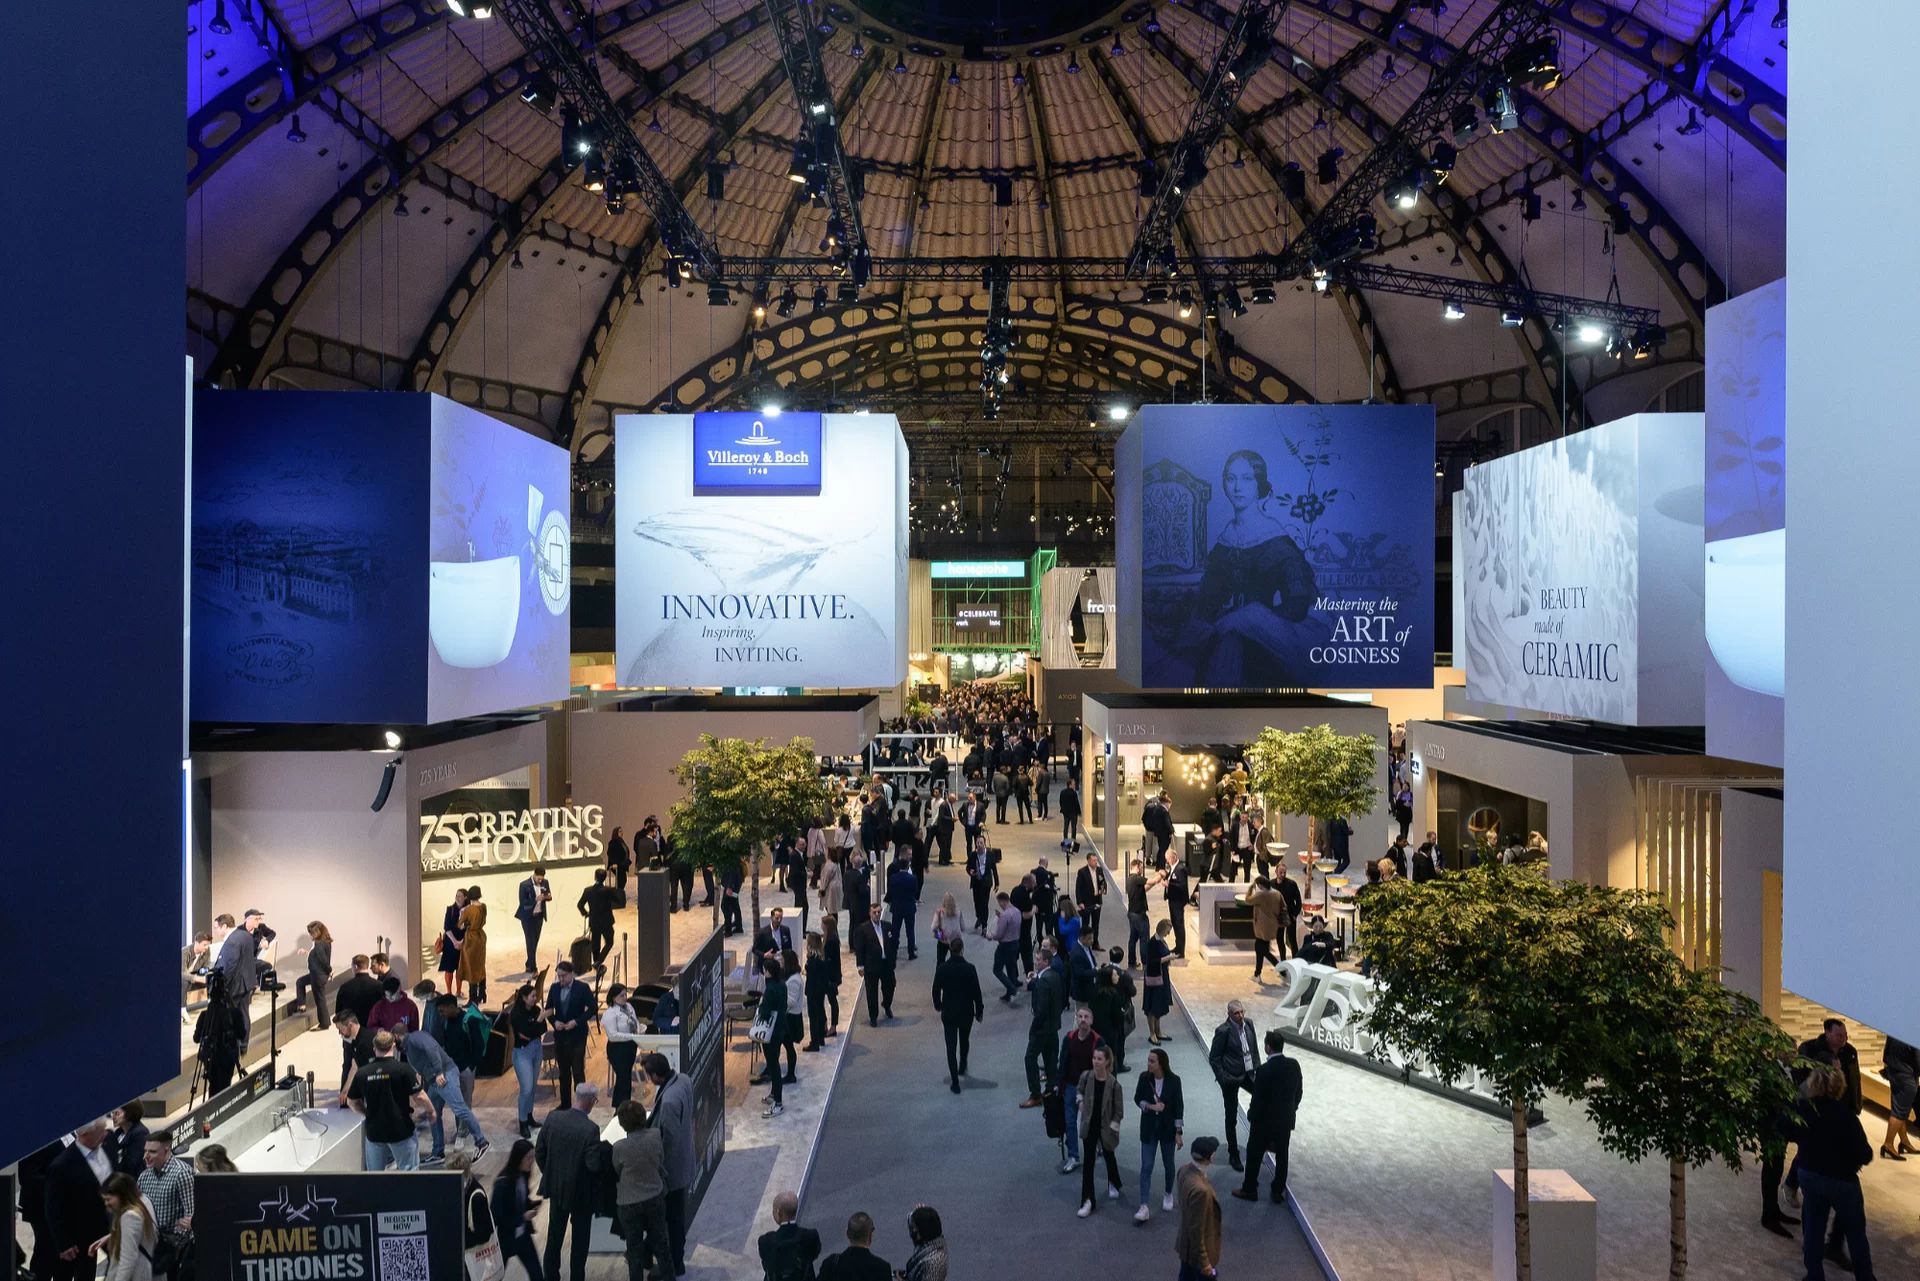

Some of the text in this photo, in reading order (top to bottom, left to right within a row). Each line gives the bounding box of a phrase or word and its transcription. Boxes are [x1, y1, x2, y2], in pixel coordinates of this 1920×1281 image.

[707, 450, 809, 465] Villeroy & Boch
[748, 467, 768, 475] 1748
[948, 561, 1009, 576] hansgrohe
[661, 594, 855, 620] INNOVATIVE.
[1314, 596, 1399, 615] Mastering the
[1540, 586, 1588, 610] BEAUTY
[702, 625, 757, 642] Inspiring.
[1330, 615, 1413, 647] ART of
[1534, 614, 1566, 640] made of
[715, 647, 803, 663] INVITING.
[1309, 647, 1400, 664] COSINESS
[1522, 641, 1619, 683] CERAMIC
[1116, 723, 1147, 736] TAPS
[1424, 743, 1446, 761] ANTAO
[419, 762, 458, 787] 275 YEARS
[421, 804, 604, 861] 75 CREATING
[422, 826, 604, 872] YEARS HOMES
[1273, 957, 1367, 1036] 275
[1309, 1024, 1351, 1051] YEARS
[383, 1213, 420, 1224] REGISTER
[392, 1223, 412, 1231] NOW
[239, 1223, 362, 1256] GAME ON
[240, 1253, 365, 1281] THRONES
